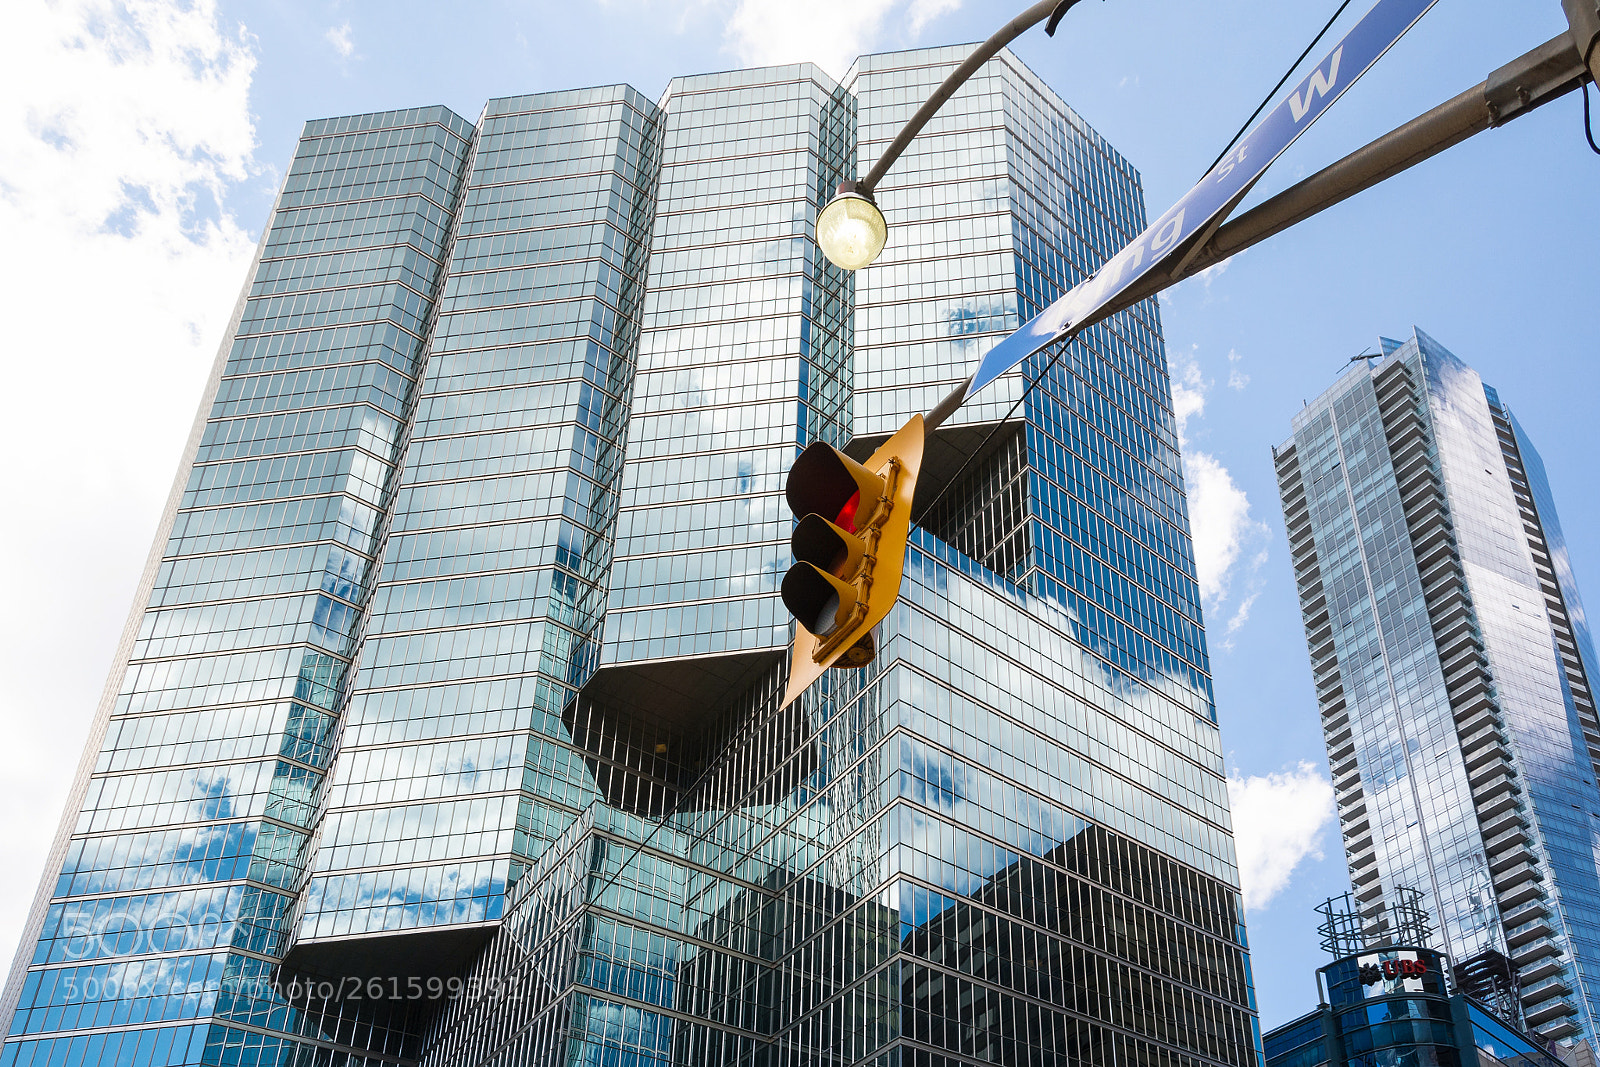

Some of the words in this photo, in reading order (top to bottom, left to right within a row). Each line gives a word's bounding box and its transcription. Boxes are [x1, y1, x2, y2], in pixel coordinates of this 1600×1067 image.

[1216, 145, 1249, 184] St
[1288, 44, 1344, 124] W
[1383, 959, 1428, 978] UBS
